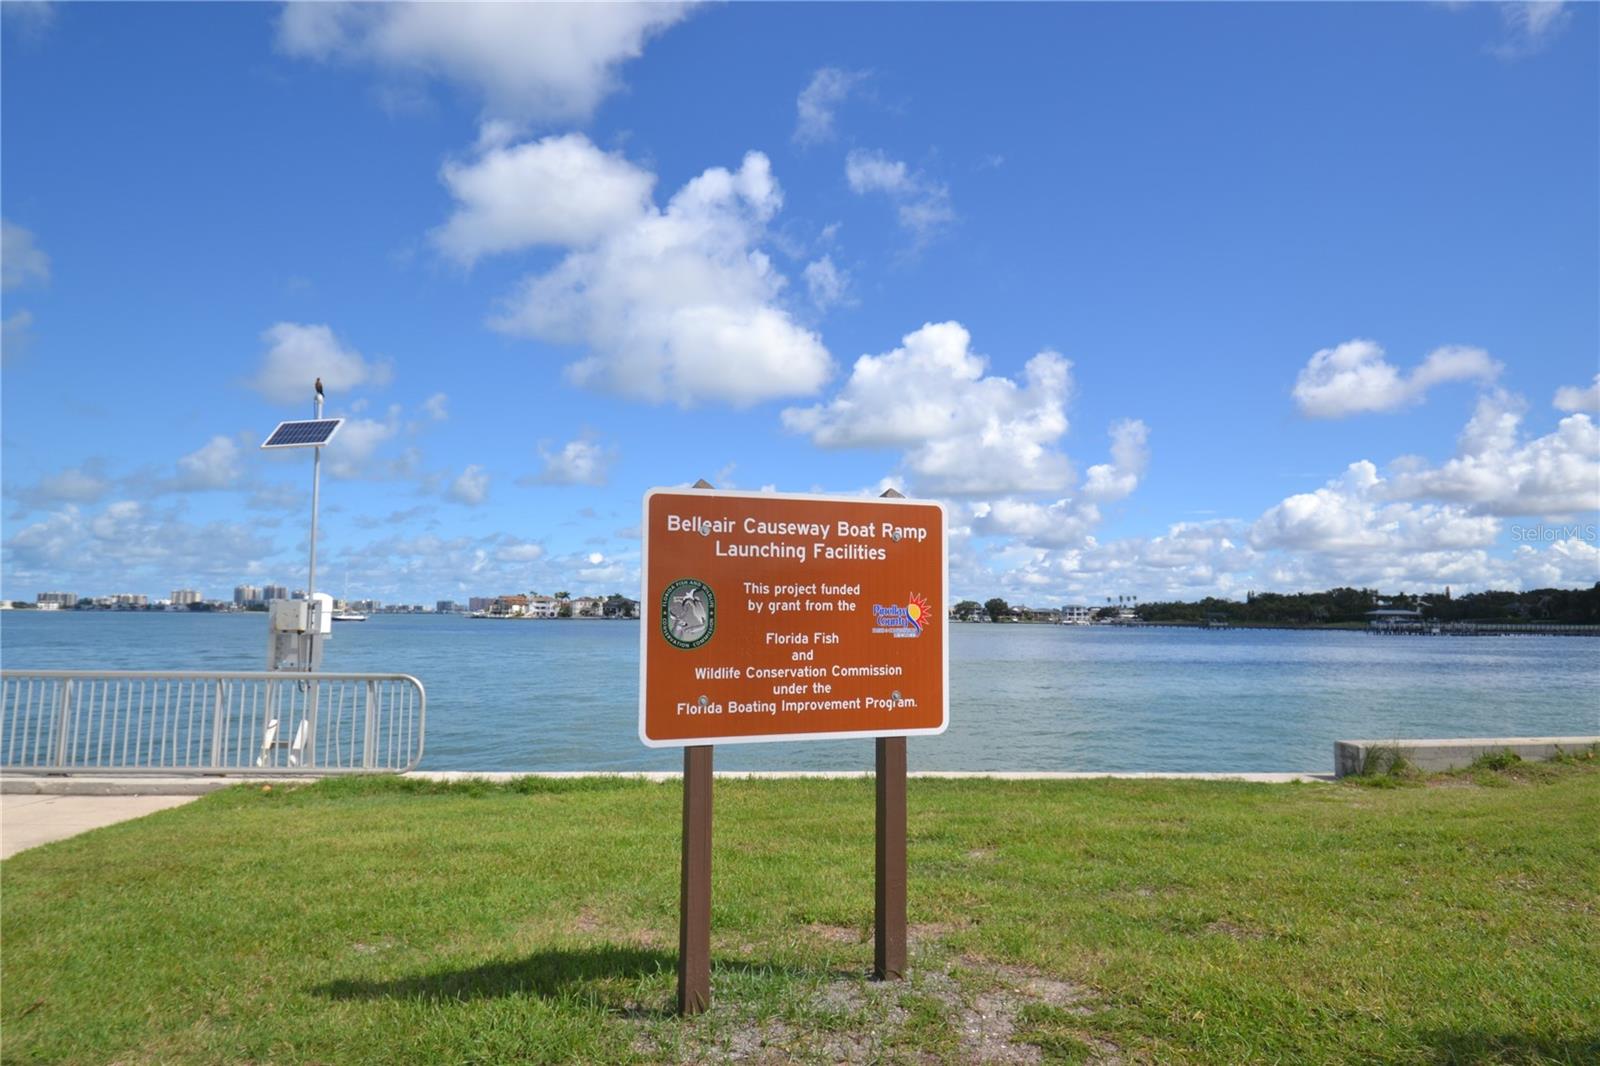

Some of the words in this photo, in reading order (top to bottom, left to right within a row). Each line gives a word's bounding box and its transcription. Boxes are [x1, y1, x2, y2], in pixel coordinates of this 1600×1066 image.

[667, 515, 736, 533] Belleair
[743, 517, 831, 540] Causeway
[837, 521, 875, 537] Boat
[882, 522, 927, 542] Ramp
[716, 540, 806, 563] Launching
[813, 542, 886, 560] Facilities
[743, 582, 770, 595] This
[774, 583, 817, 597] project
[821, 583, 861, 595] funded
[747, 599, 763, 613] by
[768, 600, 801, 614] grant
[805, 600, 833, 611] from
[837, 600, 857, 611] the
[766, 632, 809, 644] Florida
[813, 632, 839, 644] Fish
[791, 649, 814, 661] and
[695, 667, 741, 680] Wildlife
[745, 665, 827, 679] Conservation
[831, 664, 902, 677] Commission
[773, 683, 808, 695] under
[812, 682, 832, 694] the
[677, 702, 723, 715] Florida
[728, 700, 777, 716] Boating
[781, 697, 861, 714] Improvement
[865, 697, 918, 712] Program.
